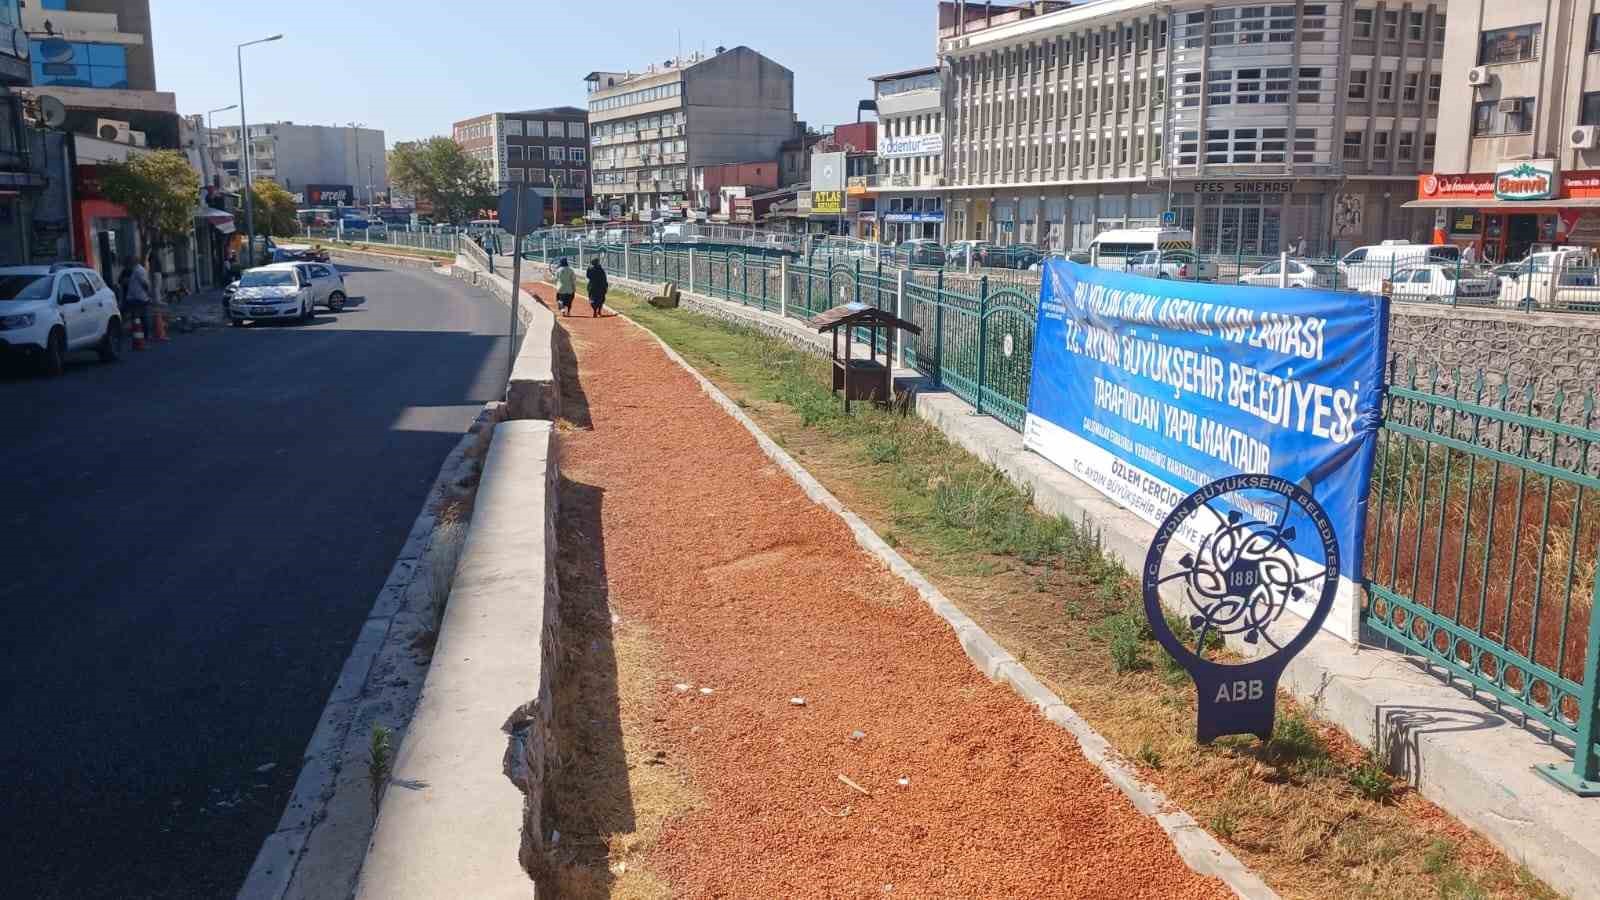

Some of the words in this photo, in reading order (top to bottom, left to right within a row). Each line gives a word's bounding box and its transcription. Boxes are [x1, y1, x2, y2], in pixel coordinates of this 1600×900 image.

[1194, 181, 1225, 192] EFES
[1500, 177, 1548, 194] Banvit
[1159, 298, 1214, 336] ASFALT
[1214, 305, 1328, 361] KAPLAMASI
[1066, 319, 1083, 354] T.C.
[1085, 324, 1121, 366] AYDIN
[1122, 328, 1224, 402] BÜYÜKŞEHİR
[1227, 367, 1360, 445] BELEDİYESİ
[1094, 376, 1160, 433] TARAFINDAN
[1163, 404, 1271, 475] YAPILMAKTADIR
[1084, 466, 1106, 486] AYDIN
[1106, 476, 1156, 514] BÜYÜKŞEHİR
[1111, 457, 1142, 487] ÖZLEM
[1155, 507, 1190, 555] AYDIN
[1230, 570, 1258, 587] 1881
[1214, 679, 1264, 704] ABB
